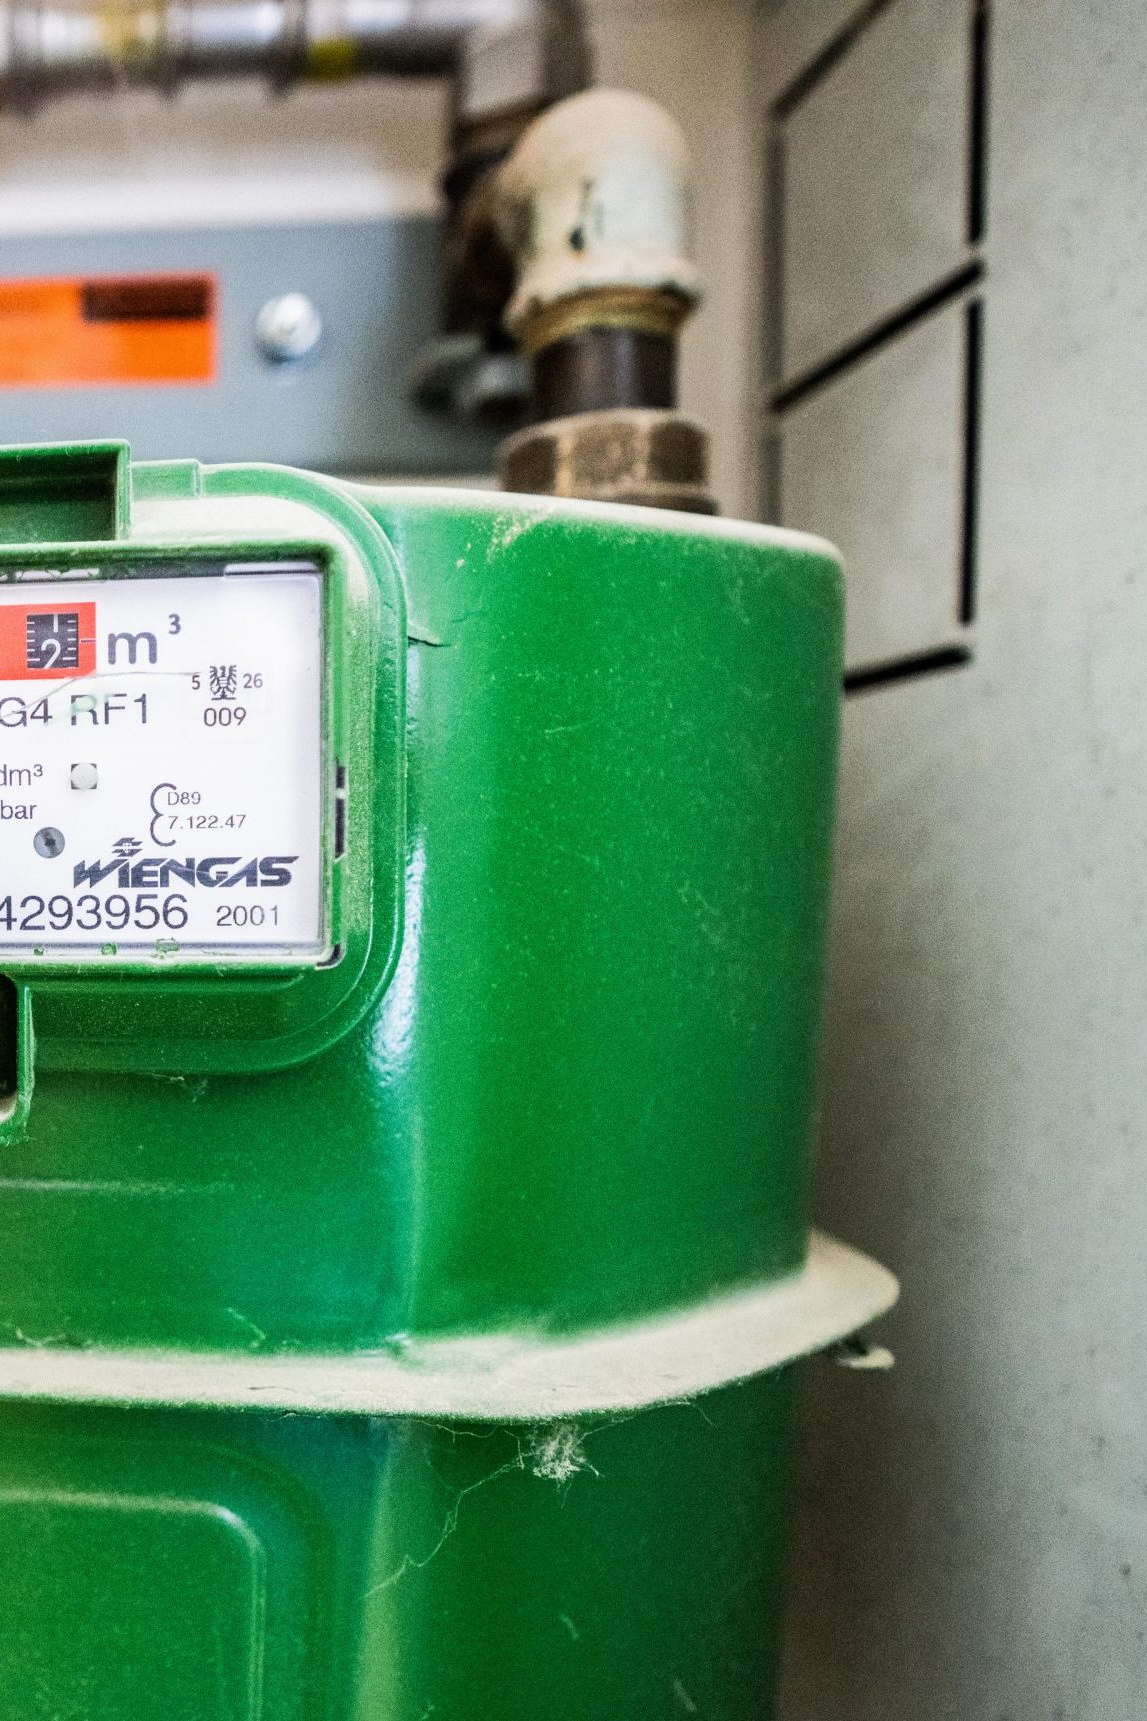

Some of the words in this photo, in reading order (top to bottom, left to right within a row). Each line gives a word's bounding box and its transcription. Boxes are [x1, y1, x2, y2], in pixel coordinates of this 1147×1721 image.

[192, 674, 200, 690] 5
[243, 673, 264, 689] 26
[71, 693, 148, 727] RF1
[203, 706, 246, 727] 009
[167, 791, 201, 806] D89
[0, 799, 37, 820] bar
[168, 814, 246, 829] 7.122.47
[216, 905, 279, 926] 2001
